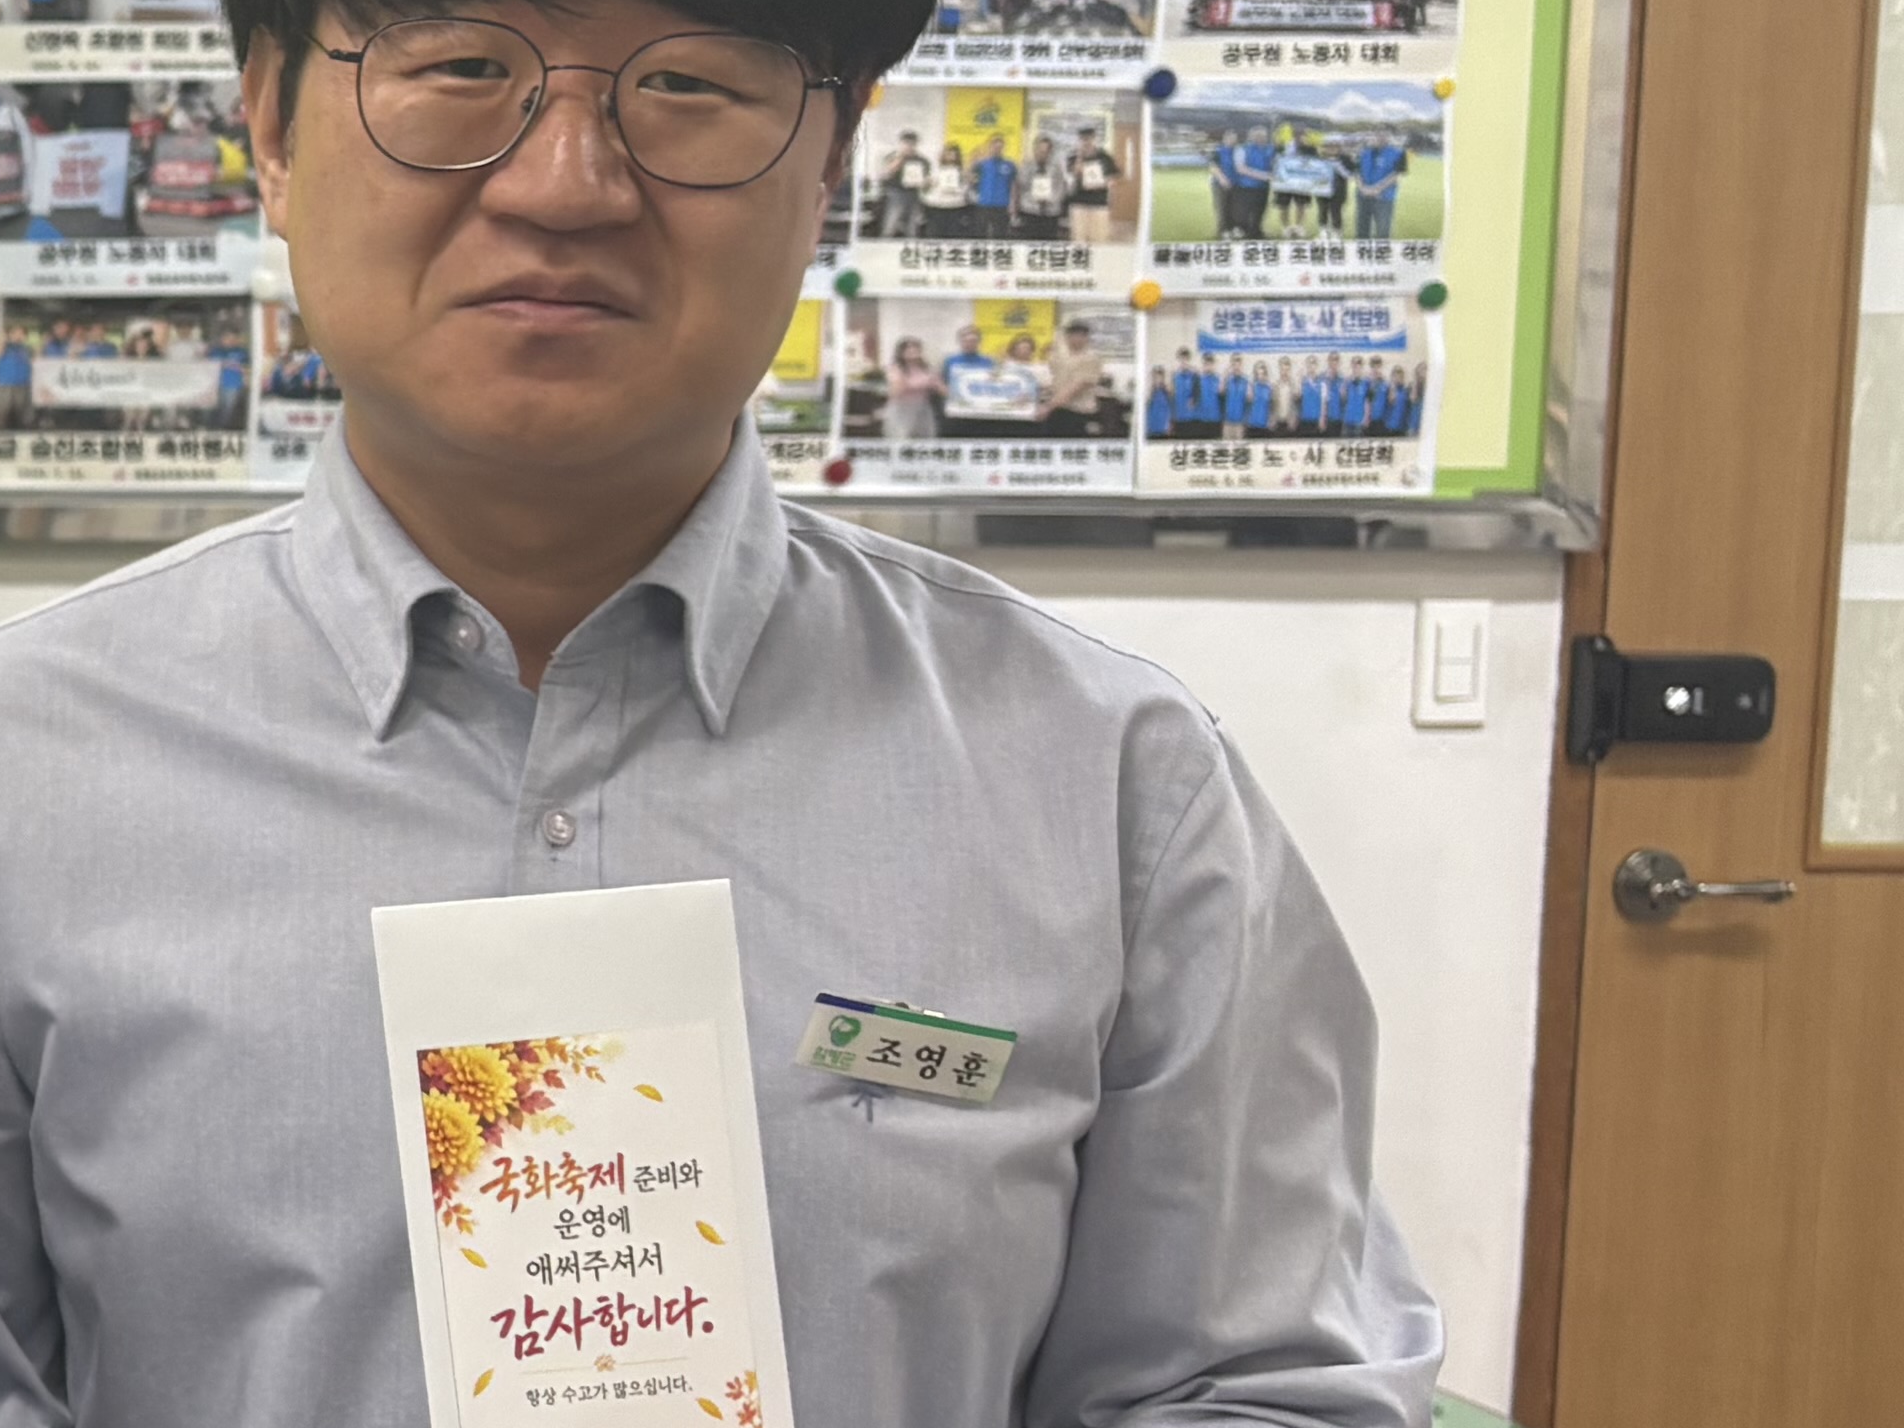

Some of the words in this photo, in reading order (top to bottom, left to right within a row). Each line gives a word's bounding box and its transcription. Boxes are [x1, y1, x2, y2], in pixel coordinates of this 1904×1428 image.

[865, 1036, 989, 1089] 조영훈
[478, 1150, 626, 1214] 국화축제
[632, 1158, 703, 1194] 준비와
[553, 1204, 632, 1240] 운영에
[525, 1242, 665, 1287] 애써주셔서
[489, 1285, 716, 1362] 감사합니다.
[561, 1382, 608, 1403] 수고가
[612, 1375, 694, 1400] 많으십니다.
